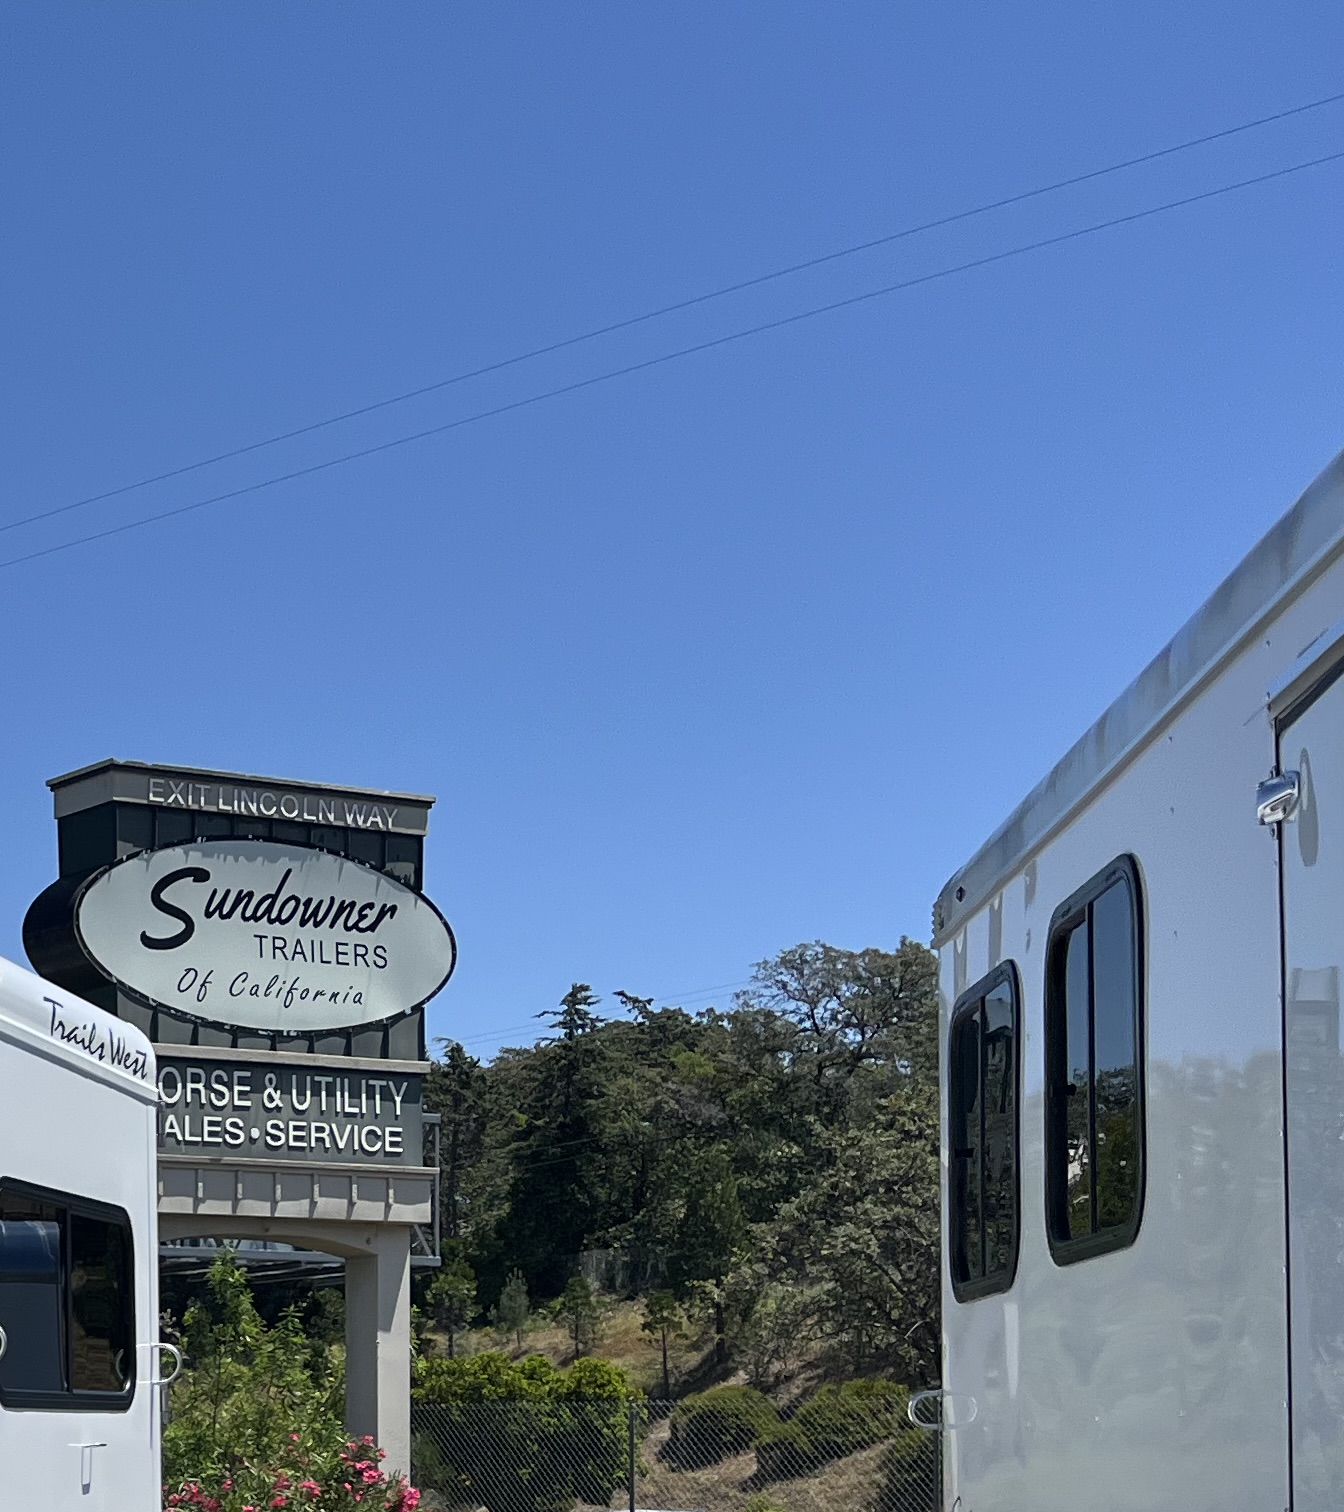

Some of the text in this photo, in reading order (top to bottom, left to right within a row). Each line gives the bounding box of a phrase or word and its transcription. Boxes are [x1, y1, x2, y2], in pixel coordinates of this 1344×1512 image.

[148, 778, 398, 829] EXIT LINCOLN WAY
[140, 866, 398, 950] Sundowner
[253, 934, 388, 969] TRAILERS
[177, 967, 363, 1009] Of California
[43, 996, 148, 1080] Trails West
[158, 1066, 408, 1116] ORSE & UTILITY
[164, 1114, 246, 1146] ALES
